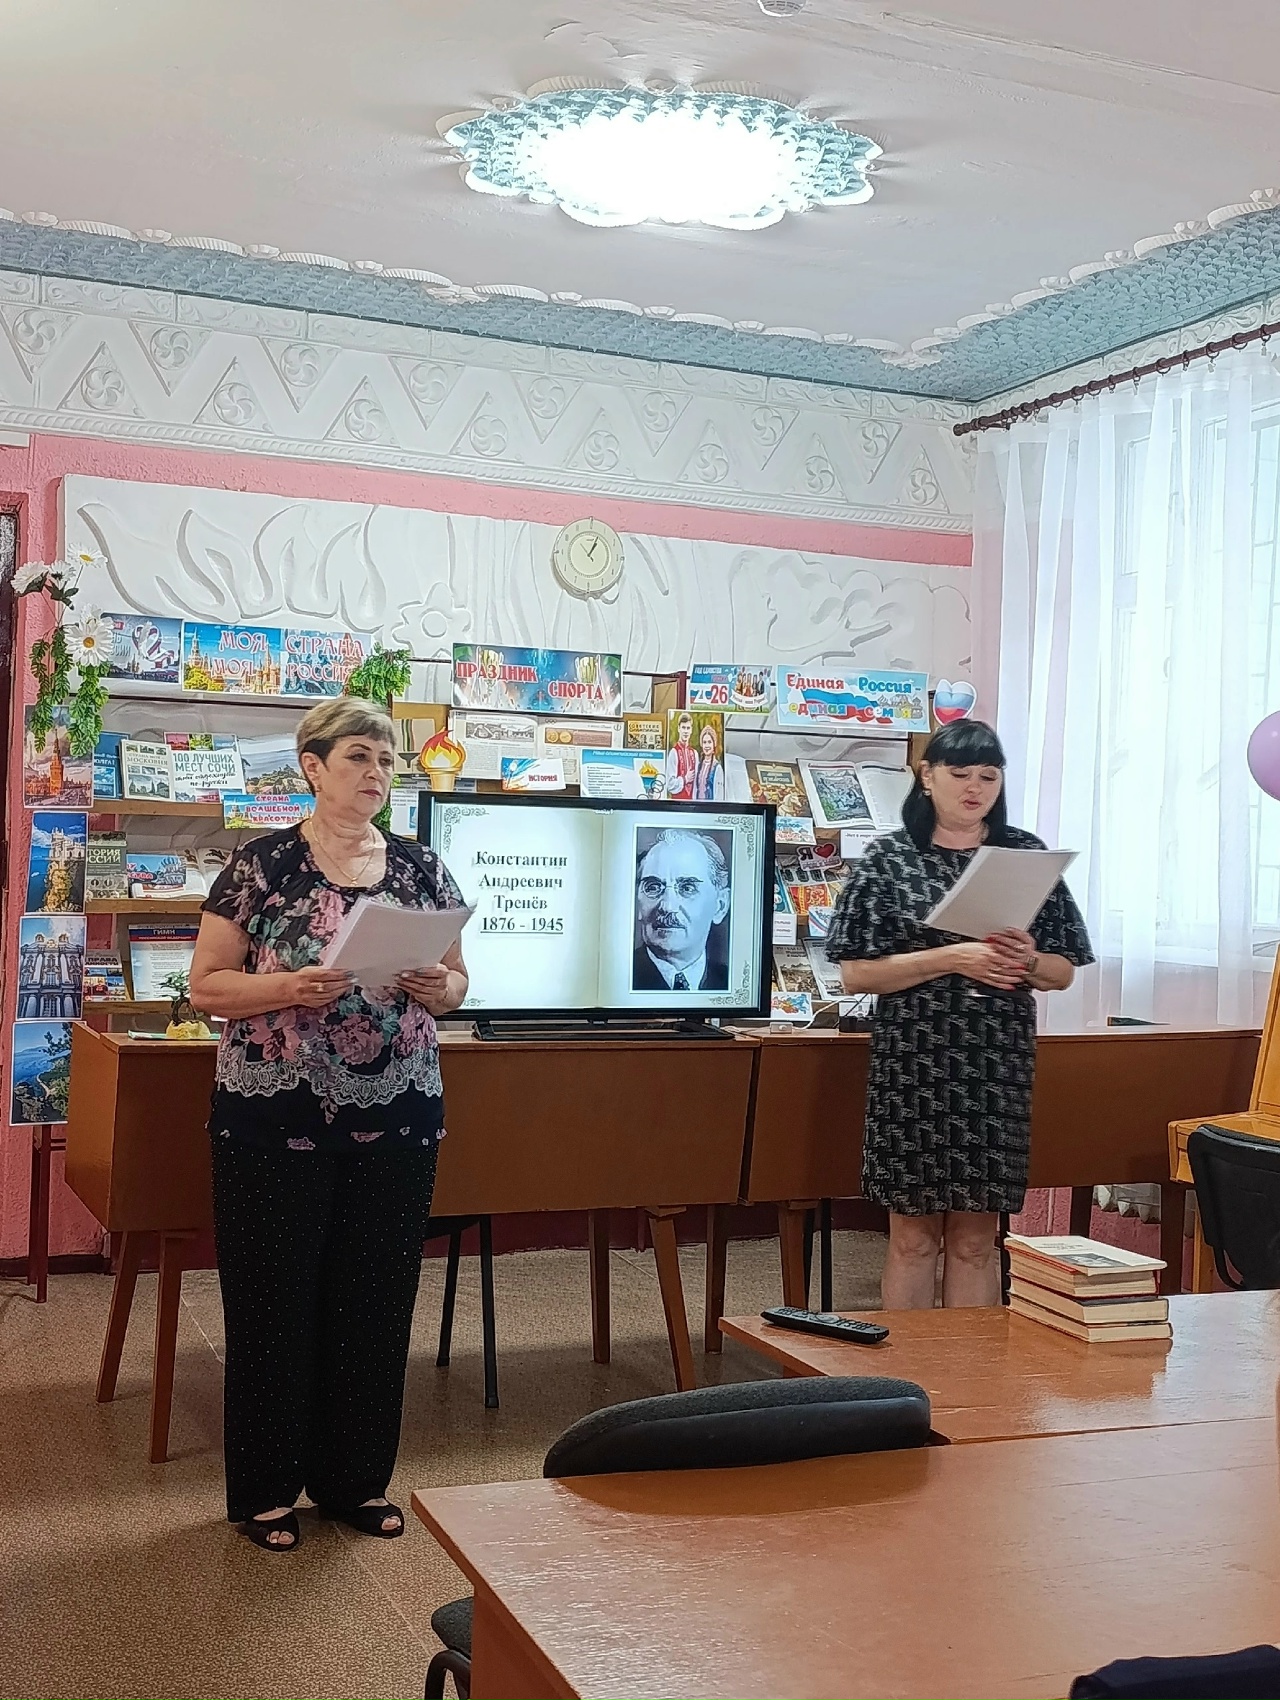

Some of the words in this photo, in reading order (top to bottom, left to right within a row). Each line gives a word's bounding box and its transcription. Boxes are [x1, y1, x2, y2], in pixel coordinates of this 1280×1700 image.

[220, 631, 267, 653] МОЯ
[211, 659, 254, 678] МОЯ
[455, 662, 538, 682] ПРАЗДНИК
[548, 681, 603, 699] СПОРТА
[786, 674, 844, 690] Единая
[858, 676, 912, 694] Россия
[788, 702, 846, 716] единая
[173, 752, 190, 763] 100
[192, 753, 233, 764] ЛУЧШИХ
[175, 762, 204, 772] МЕСТ
[208, 763, 236, 773] СОЧИ
[246, 804, 300, 812] ВОЛШЕБНОЙ
[89, 856, 121, 864] ССИИ
[475, 851, 567, 866] Константин
[798, 847, 814, 860] Я
[478, 874, 562, 891] Андреевич
[494, 895, 547, 912] Тренёв
[482, 917, 515, 931] 1876
[532, 918, 564, 932] 1945
